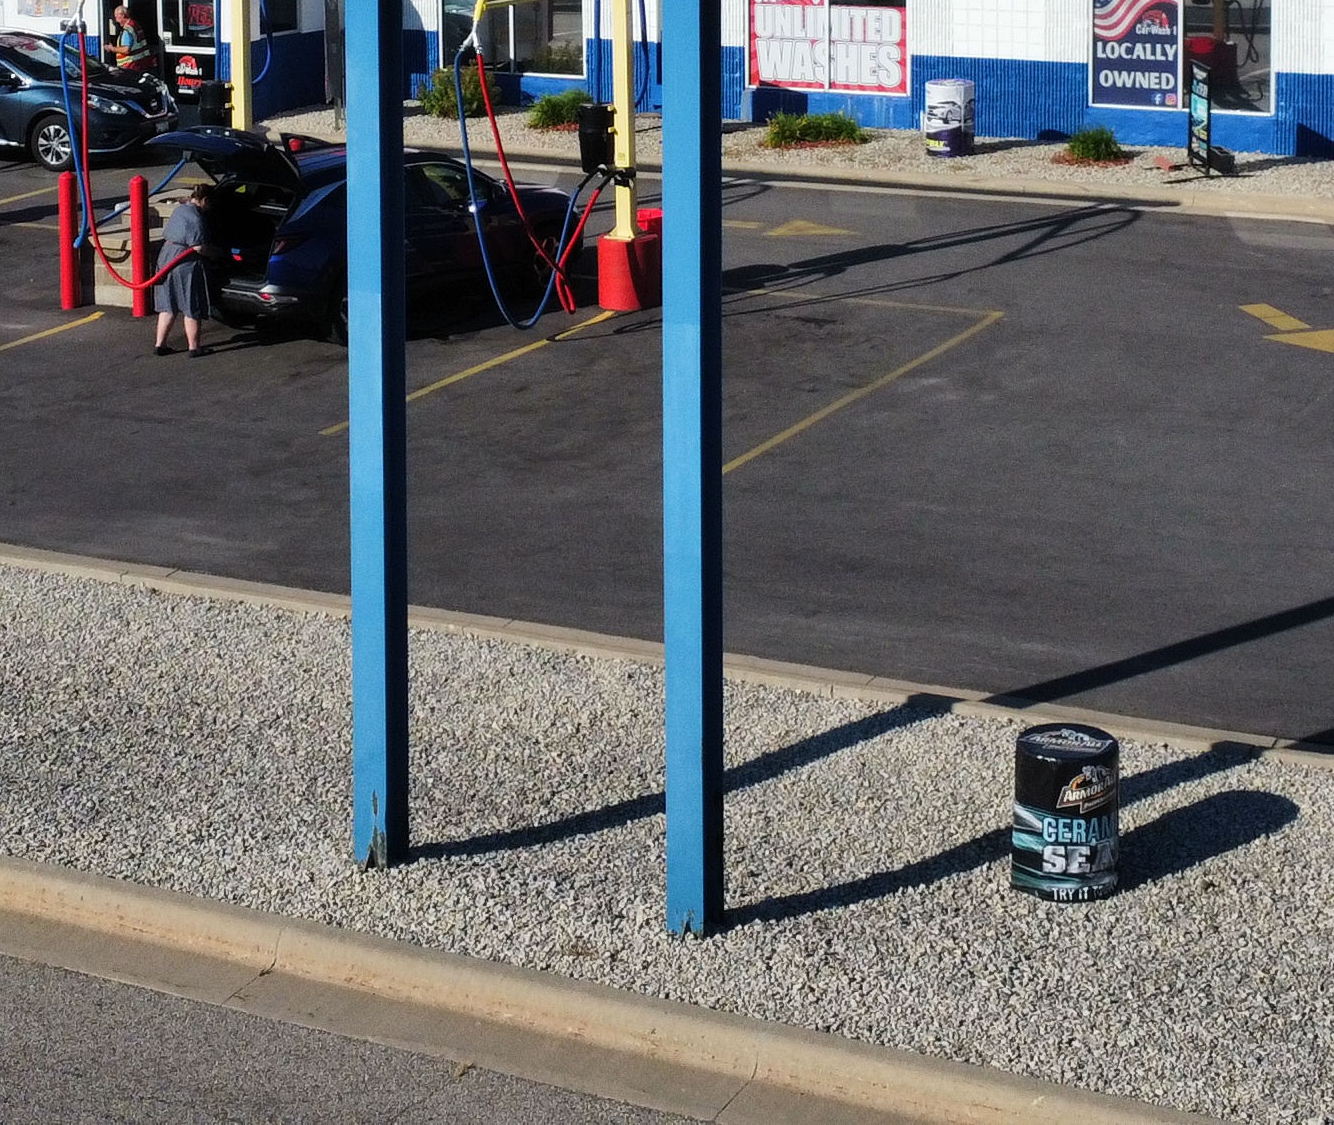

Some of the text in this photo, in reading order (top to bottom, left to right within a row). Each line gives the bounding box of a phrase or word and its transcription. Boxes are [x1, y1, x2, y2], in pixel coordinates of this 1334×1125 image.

[754, 4, 902, 44] UNLIMITED
[1135, 23, 1149, 35] Car
[1150, 24, 1171, 35] Wash
[1096, 41, 1177, 61] LOCALLY
[755, 37, 902, 87] WASHES
[1099, 70, 1175, 89] OWNED
[1063, 781, 1105, 802] ARMOR
[1042, 817, 1117, 843] CERAM
[1052, 888, 1073, 901] TRY
[1079, 886, 1089, 900] IT
